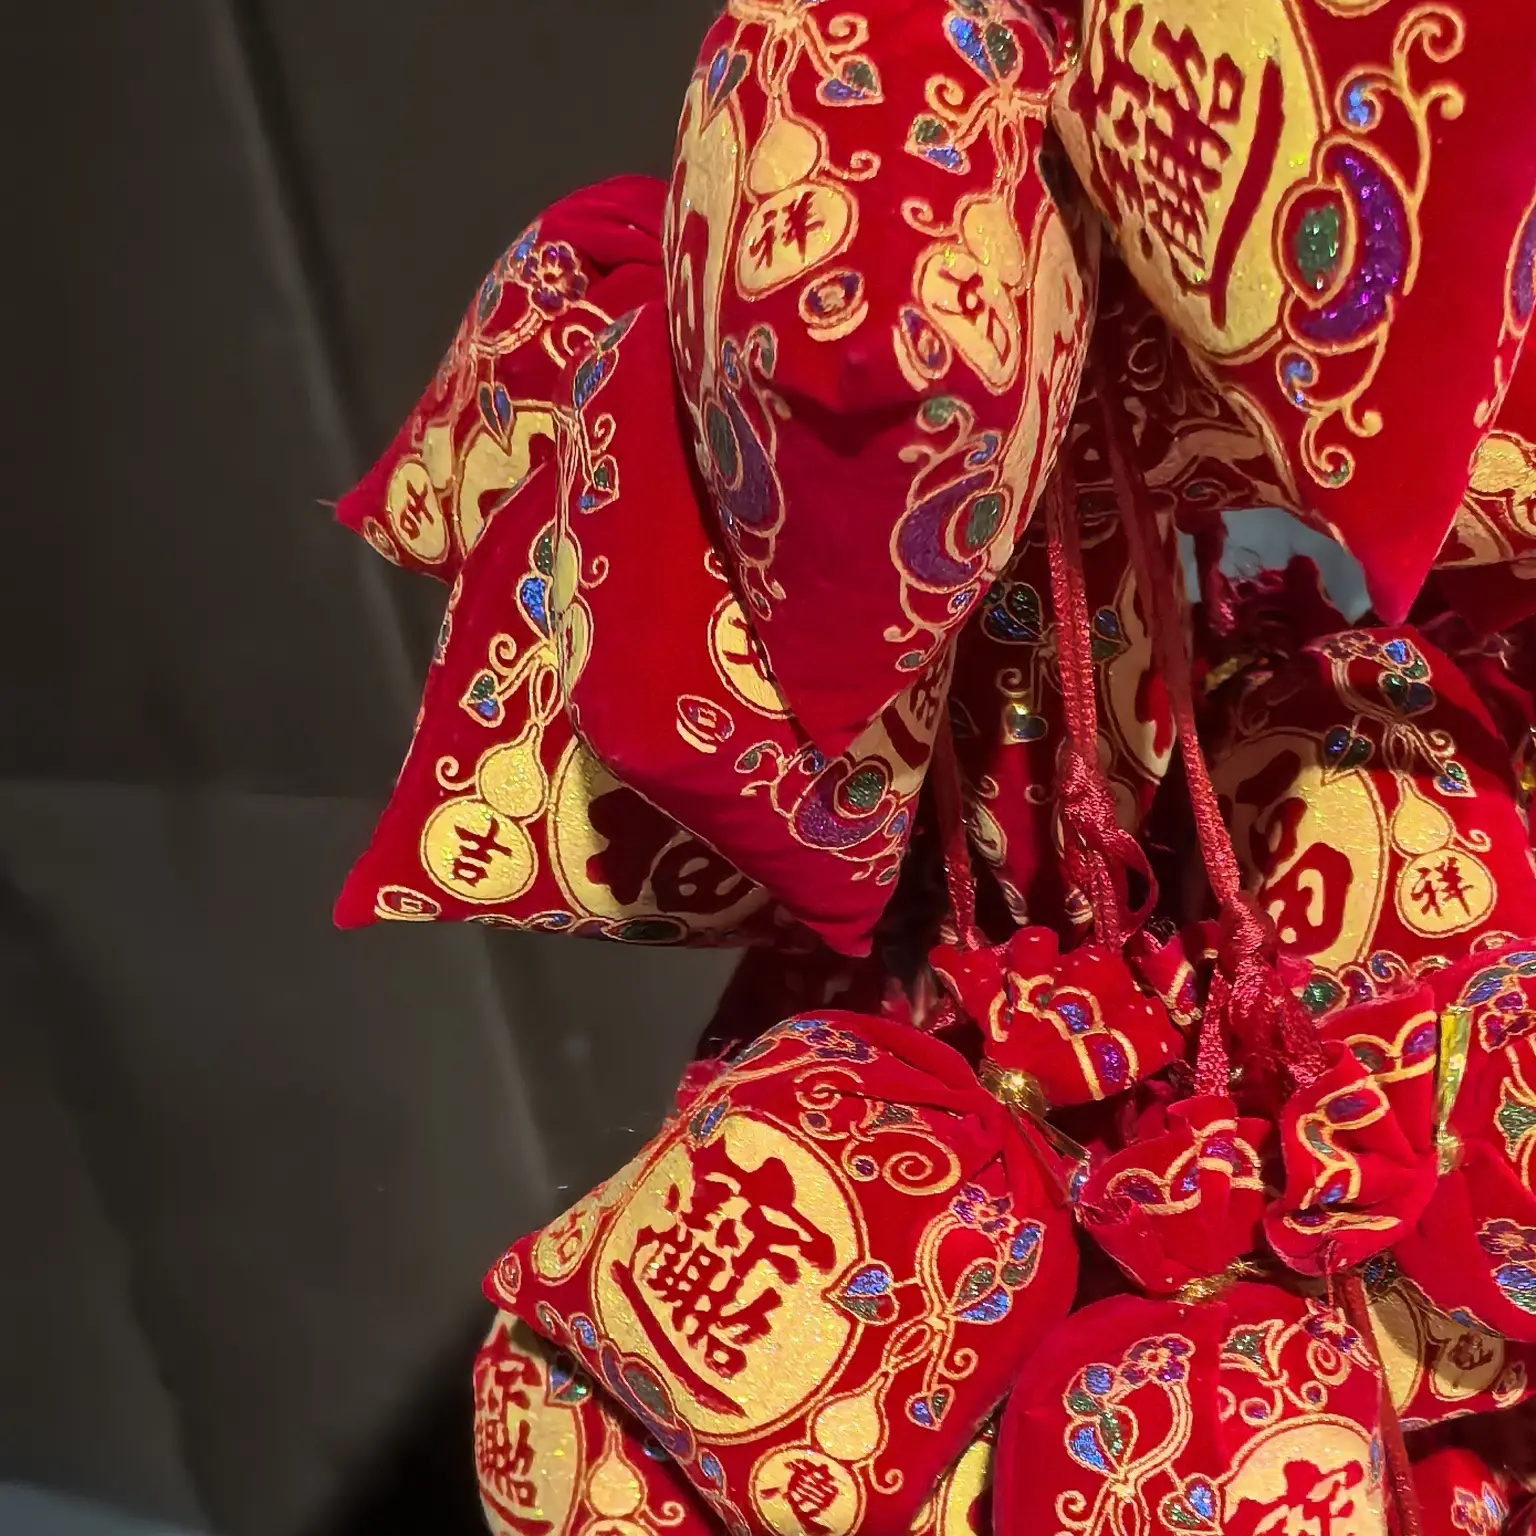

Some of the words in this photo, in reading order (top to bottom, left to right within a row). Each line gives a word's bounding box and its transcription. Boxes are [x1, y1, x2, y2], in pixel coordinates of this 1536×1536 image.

[748, 190, 827, 270] 祥
[446, 820, 512, 887] 吉
[1409, 857, 1475, 918] 祥
